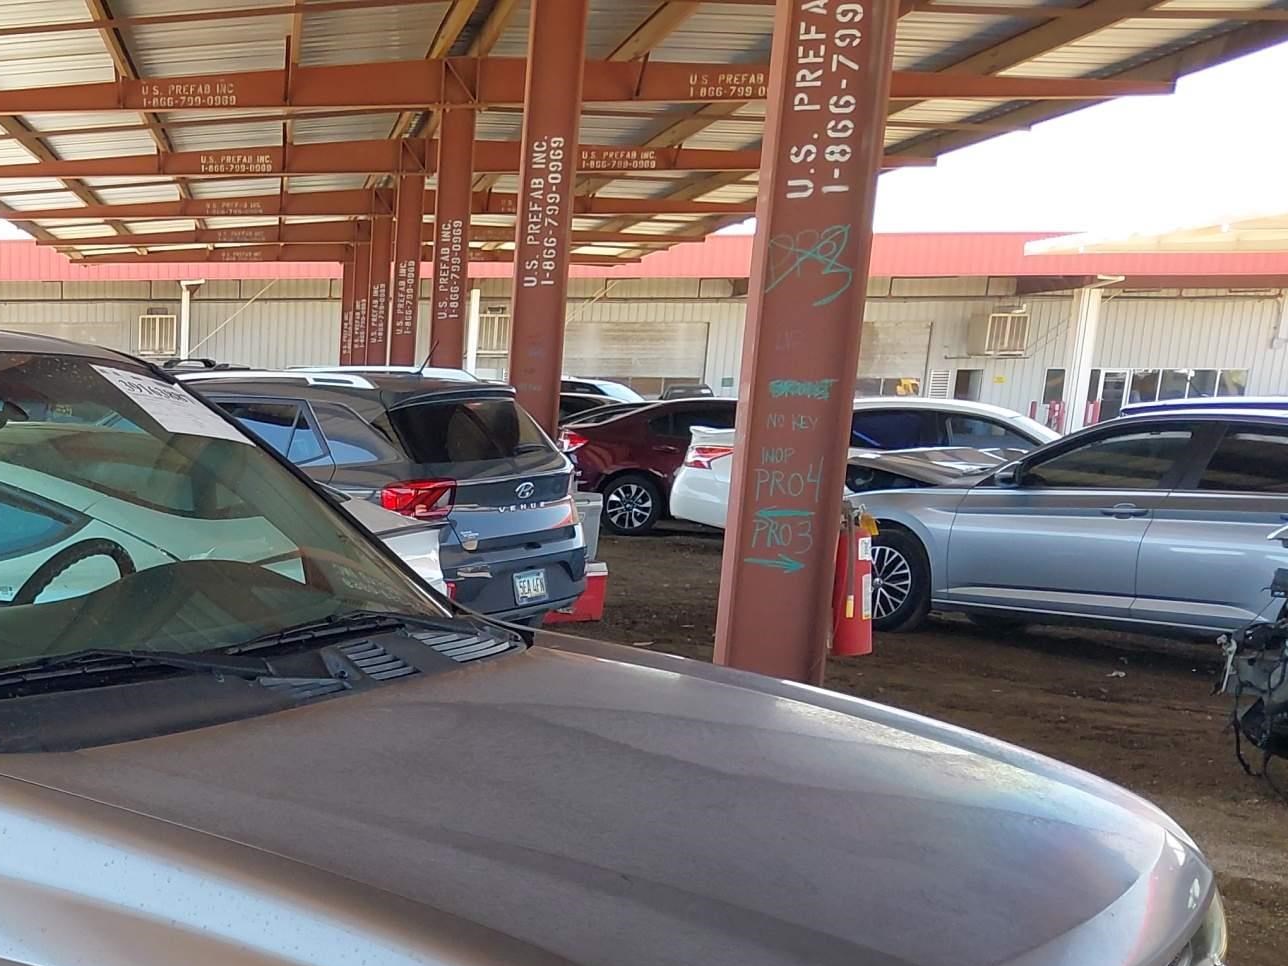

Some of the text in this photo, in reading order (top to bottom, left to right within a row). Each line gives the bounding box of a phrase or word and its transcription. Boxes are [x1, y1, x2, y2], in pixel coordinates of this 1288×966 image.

[168, 82, 211, 95] PREFAB
[718, 73, 765, 85] PREFAB
[220, 154, 253, 164] PREFAB
[602, 151, 637, 160] PREFAB
[786, 132, 819, 199] U.S.
[523, 135, 548, 288] U.S. PREFAB INC.
[540, 136, 565, 286] 1-866-799-0969
[441, 219, 453, 242] INC.
[439, 247, 451, 292] PREFAB
[448, 219, 463, 319] 1-866-799-0969
[397, 280, 406, 314] PREFAB
[498, 501, 545, 513] VENUE
